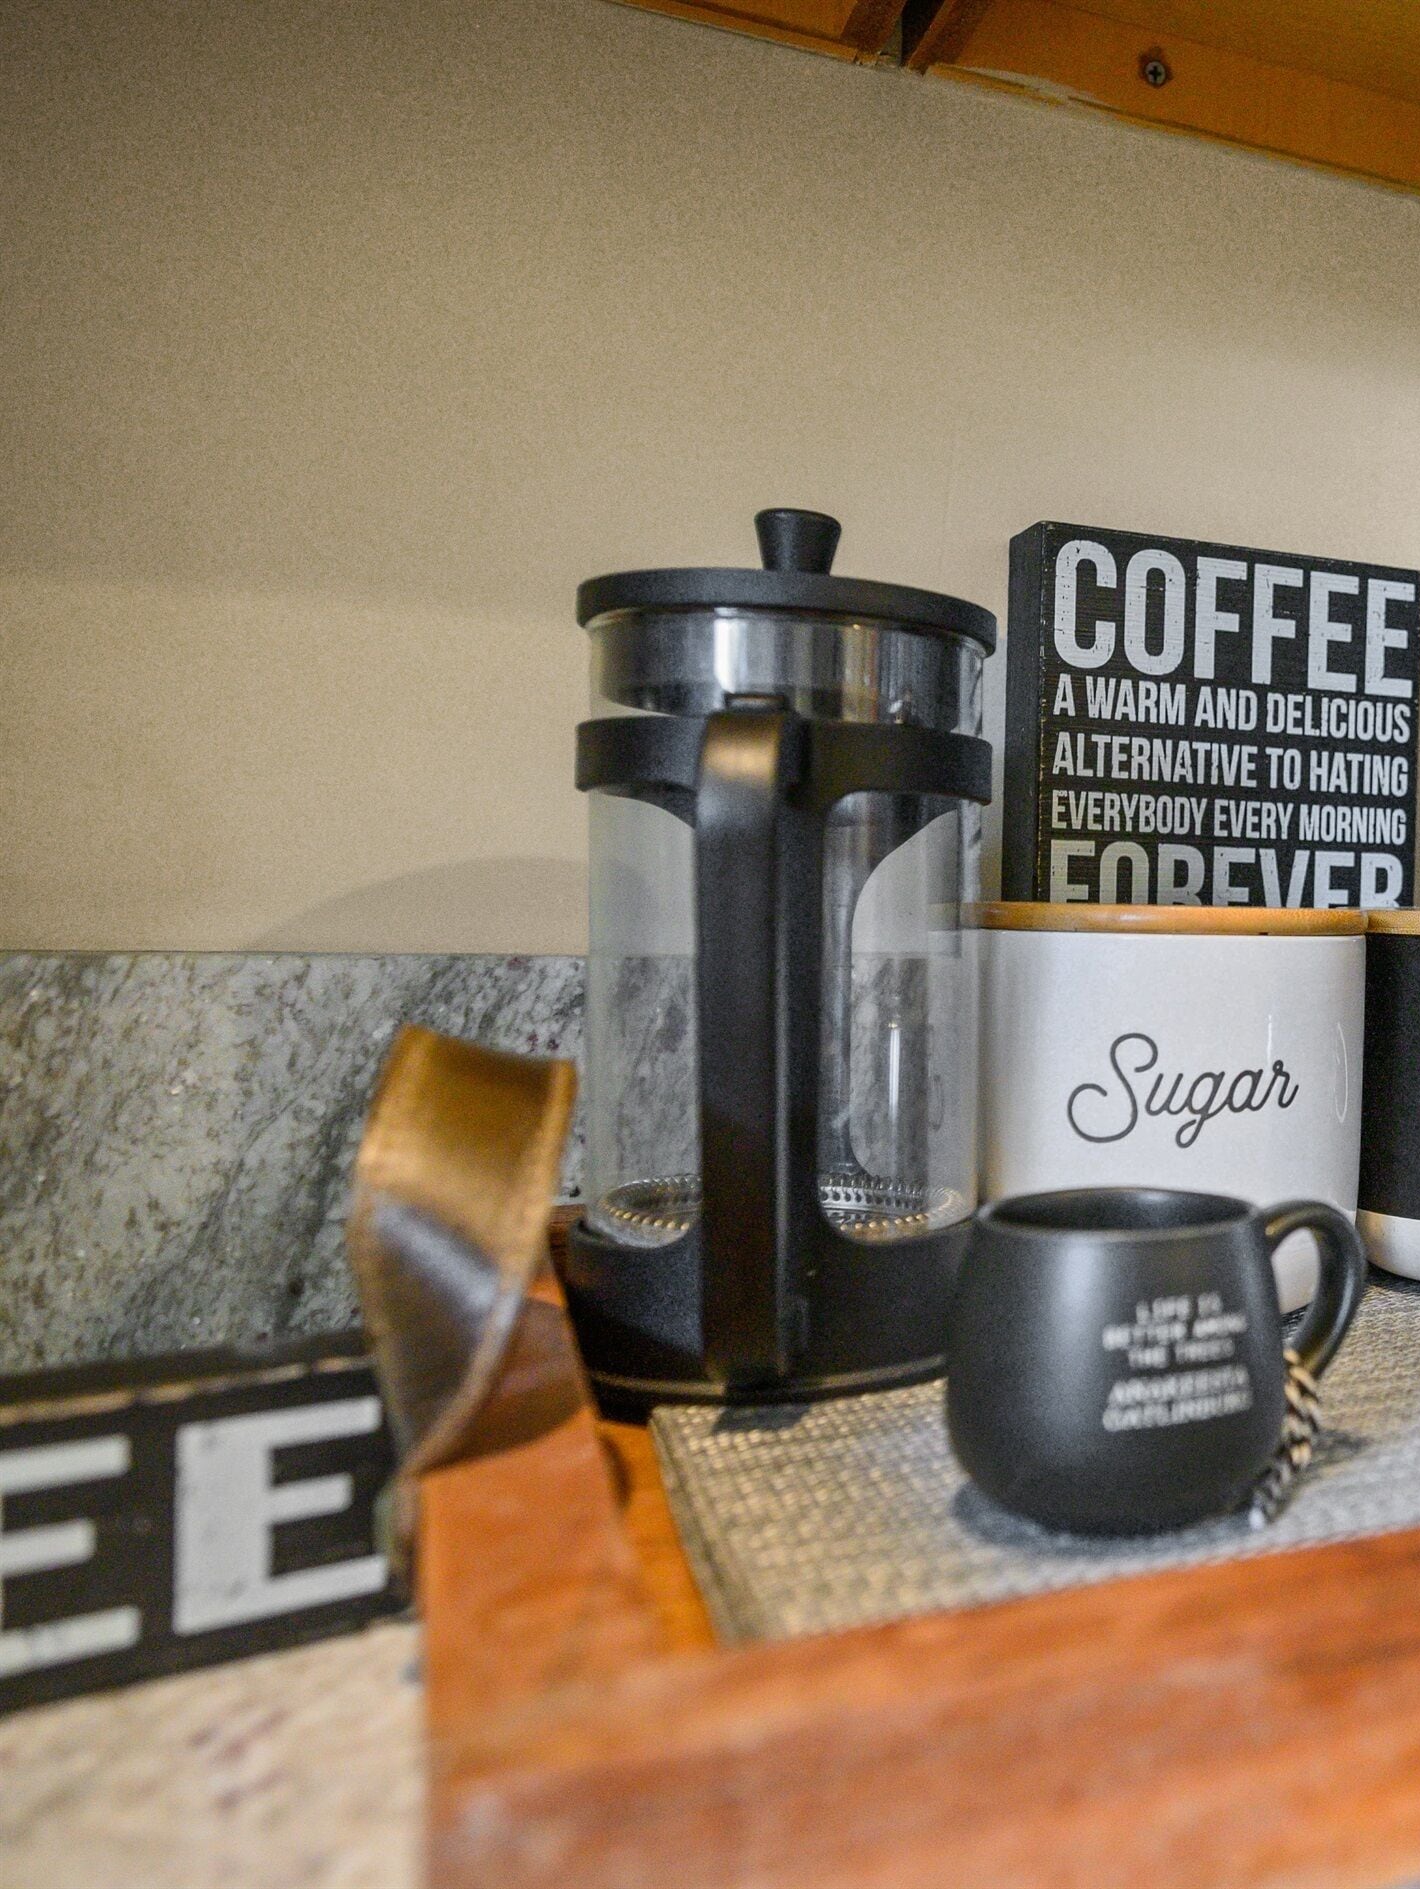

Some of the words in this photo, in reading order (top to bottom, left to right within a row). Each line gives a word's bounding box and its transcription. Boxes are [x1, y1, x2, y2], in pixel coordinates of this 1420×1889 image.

[1054, 539, 1416, 699] COFFEE
[1053, 673, 1076, 716] A
[1086, 675, 1186, 726] WARM
[1195, 687, 1257, 732] AND
[1266, 693, 1411, 743] DELICIOUS
[1052, 731, 1257, 788] ALTERNATIVE
[1265, 747, 1302, 790] TO
[1310, 750, 1409, 798] HATING
[1051, 790, 1207, 836] EVERYBODY
[1213, 799, 1294, 841] EVERY
[1299, 804, 1406, 845] MORNING
[1050, 839, 1404, 909] FOREVER
[1067, 1032, 1299, 1149] Sugar
